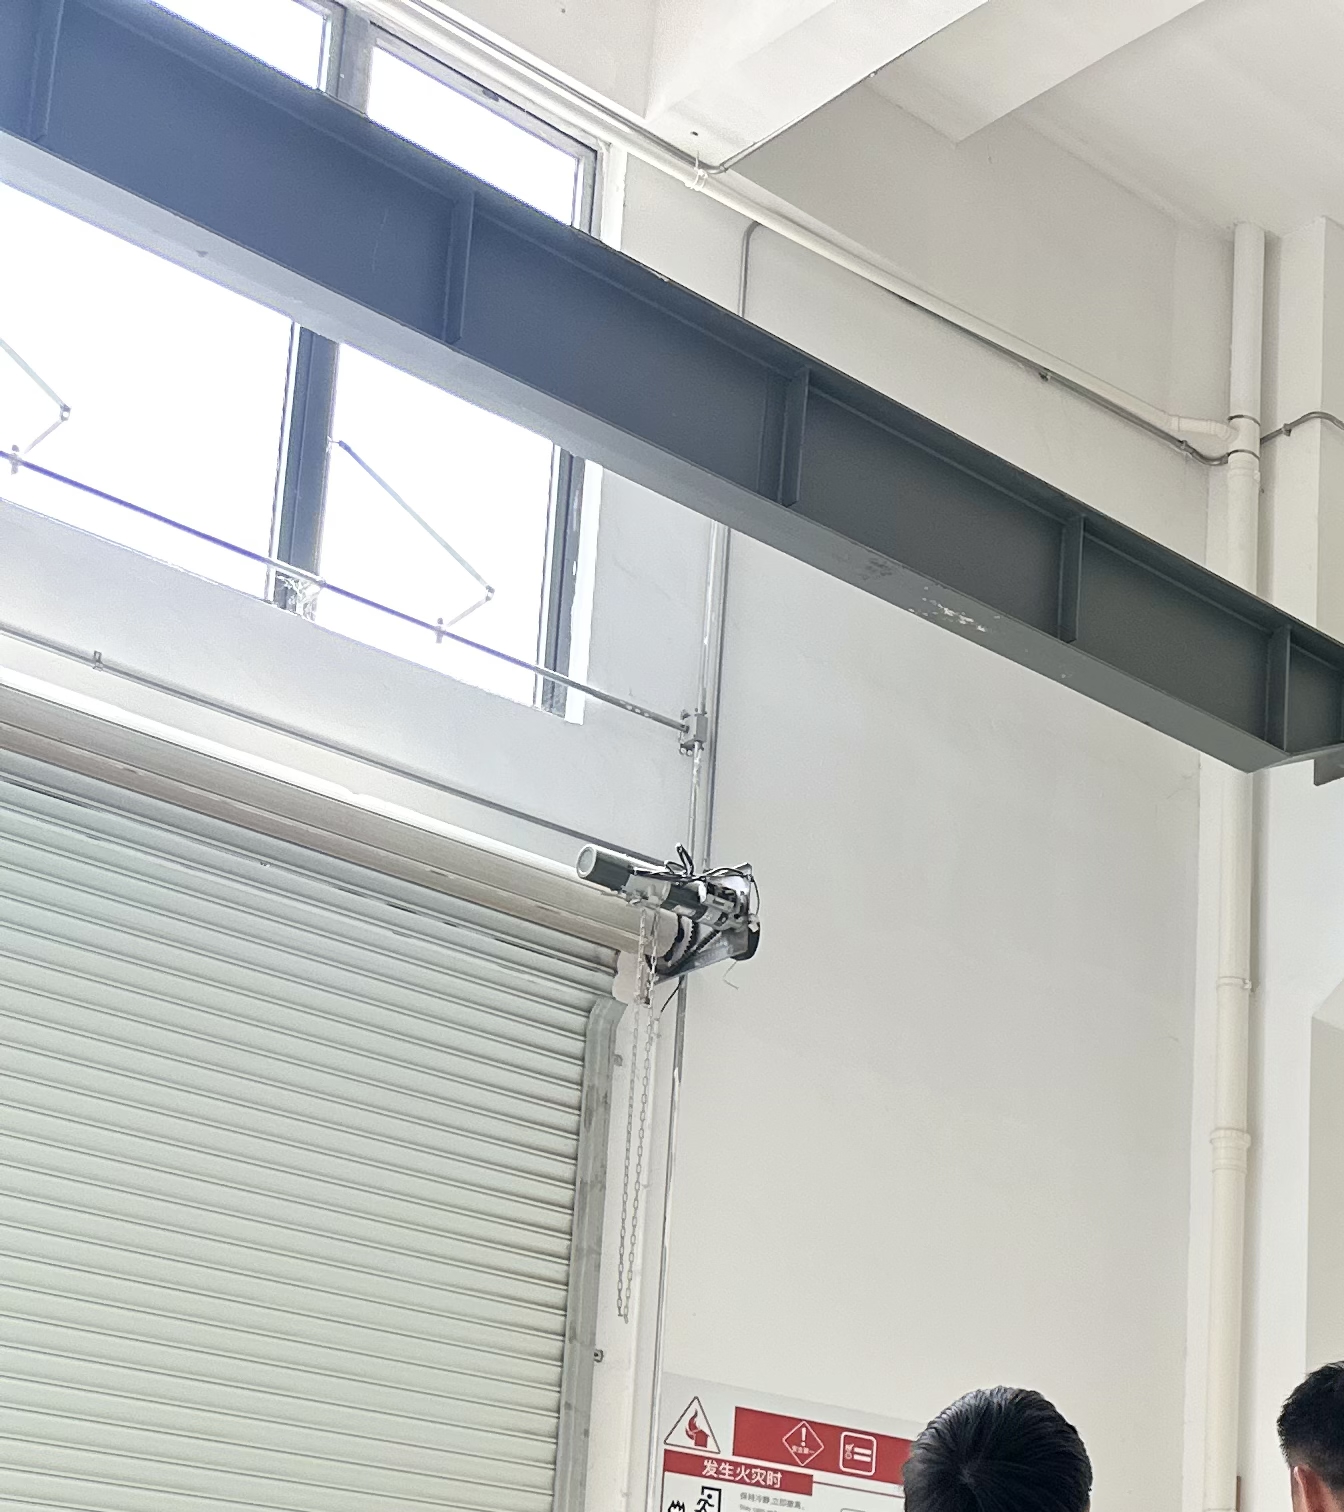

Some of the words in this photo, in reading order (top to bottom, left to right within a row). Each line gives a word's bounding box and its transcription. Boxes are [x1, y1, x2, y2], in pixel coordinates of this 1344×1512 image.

[702, 1459, 782, 1488] 发生火灾时
